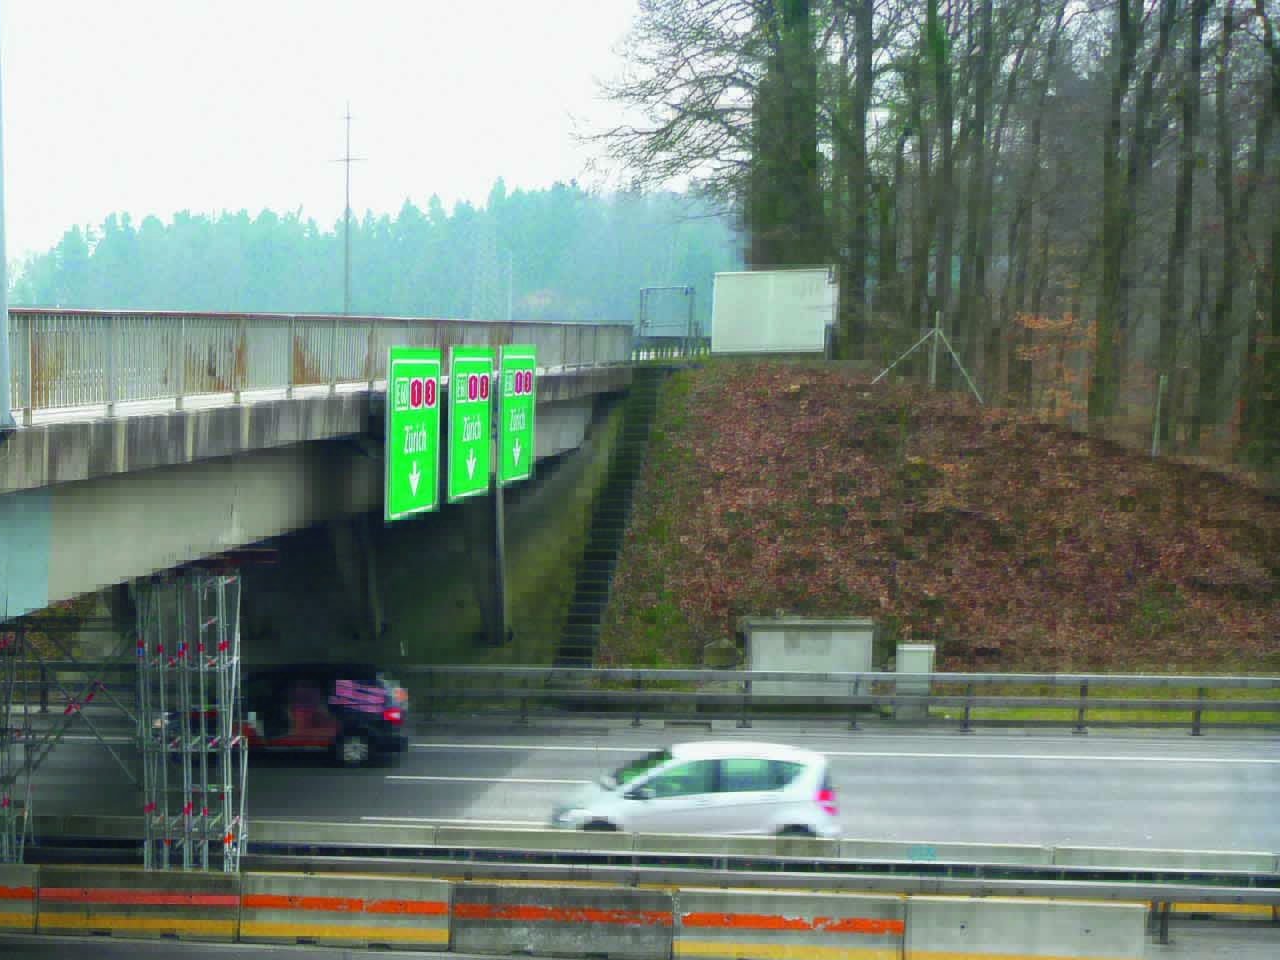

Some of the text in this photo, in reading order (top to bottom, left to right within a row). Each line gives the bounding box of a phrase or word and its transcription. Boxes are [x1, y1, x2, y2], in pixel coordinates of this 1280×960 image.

[463, 414, 481, 442] Zürich
[509, 408, 526, 432] Zürich
[404, 422, 427, 454] Zürich
